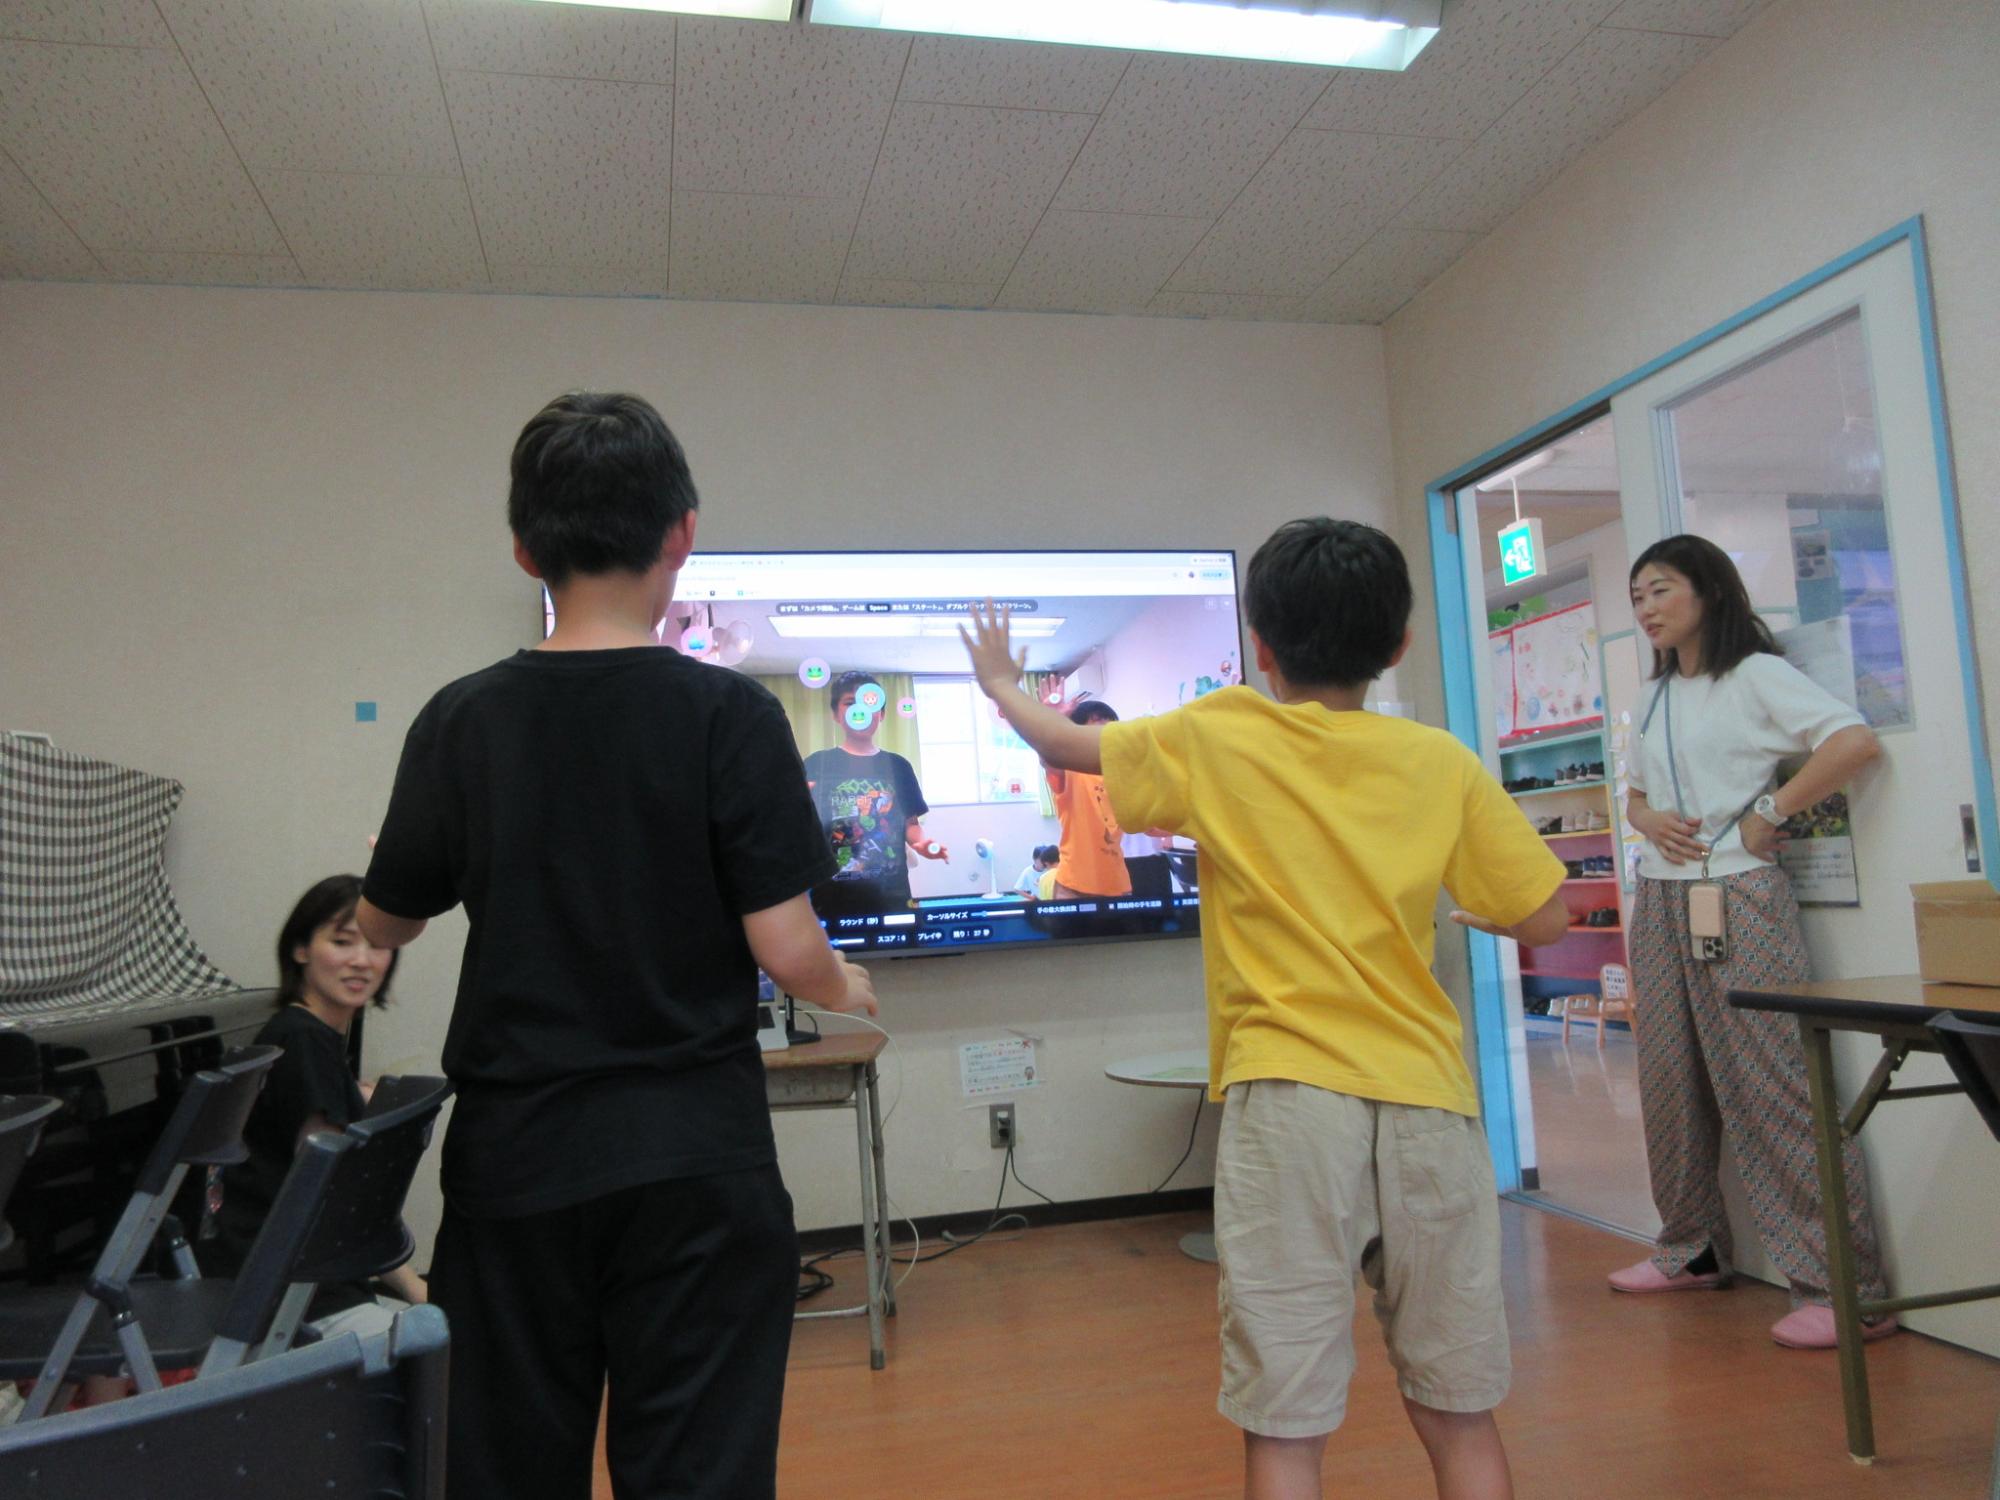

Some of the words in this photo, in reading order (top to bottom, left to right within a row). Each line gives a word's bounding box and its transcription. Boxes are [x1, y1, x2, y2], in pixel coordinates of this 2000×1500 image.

[926, 911, 968, 921] カーソルサイズ
